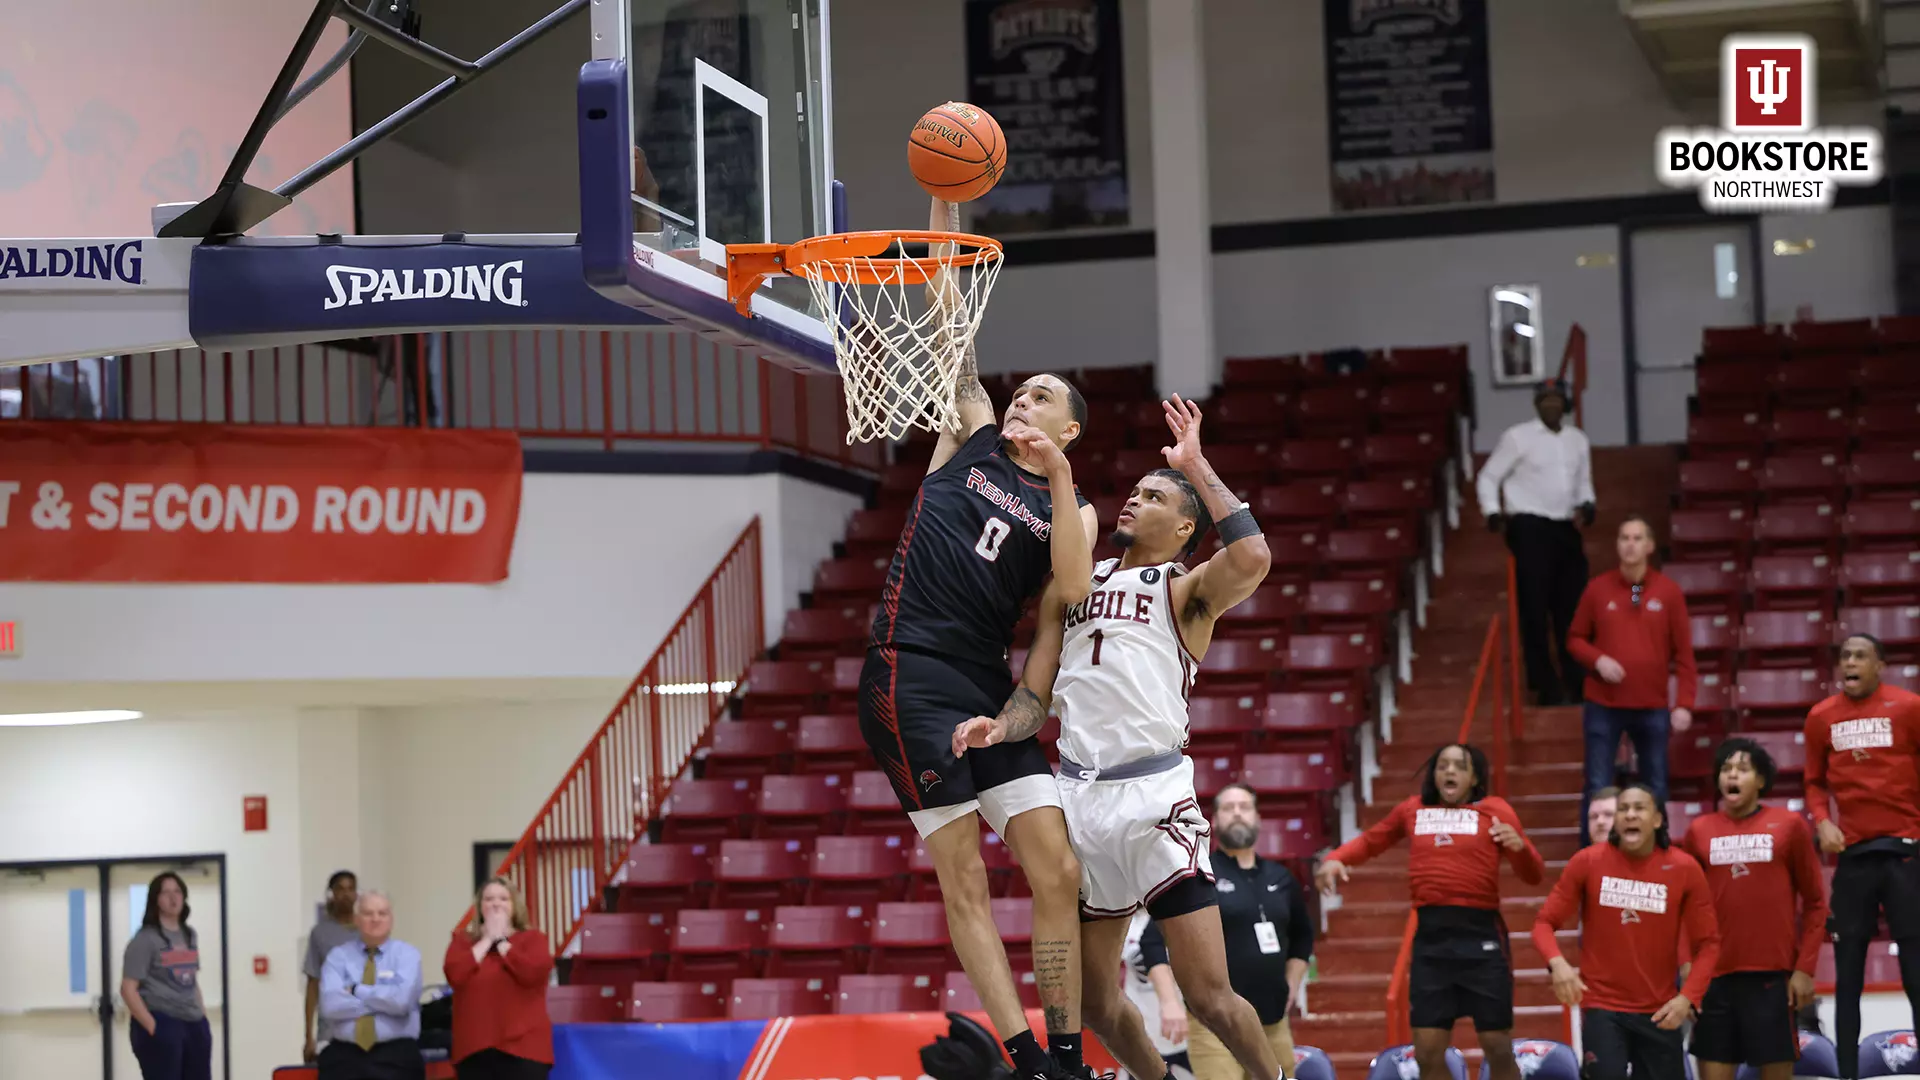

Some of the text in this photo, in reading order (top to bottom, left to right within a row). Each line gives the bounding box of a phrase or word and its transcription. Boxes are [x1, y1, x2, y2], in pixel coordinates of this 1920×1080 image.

[0, 240, 142, 285] ALDING
[324, 260, 525, 310] SPALDING
[31, 481, 72, 530] &
[86, 482, 299, 533] SECOND
[312, 485, 486, 534] ROUND
[975, 517, 1011, 562] 0
[1062, 590, 1153, 632] OBILE
[0, 621, 15, 652] IT
[1088, 629, 1104, 666] 1
